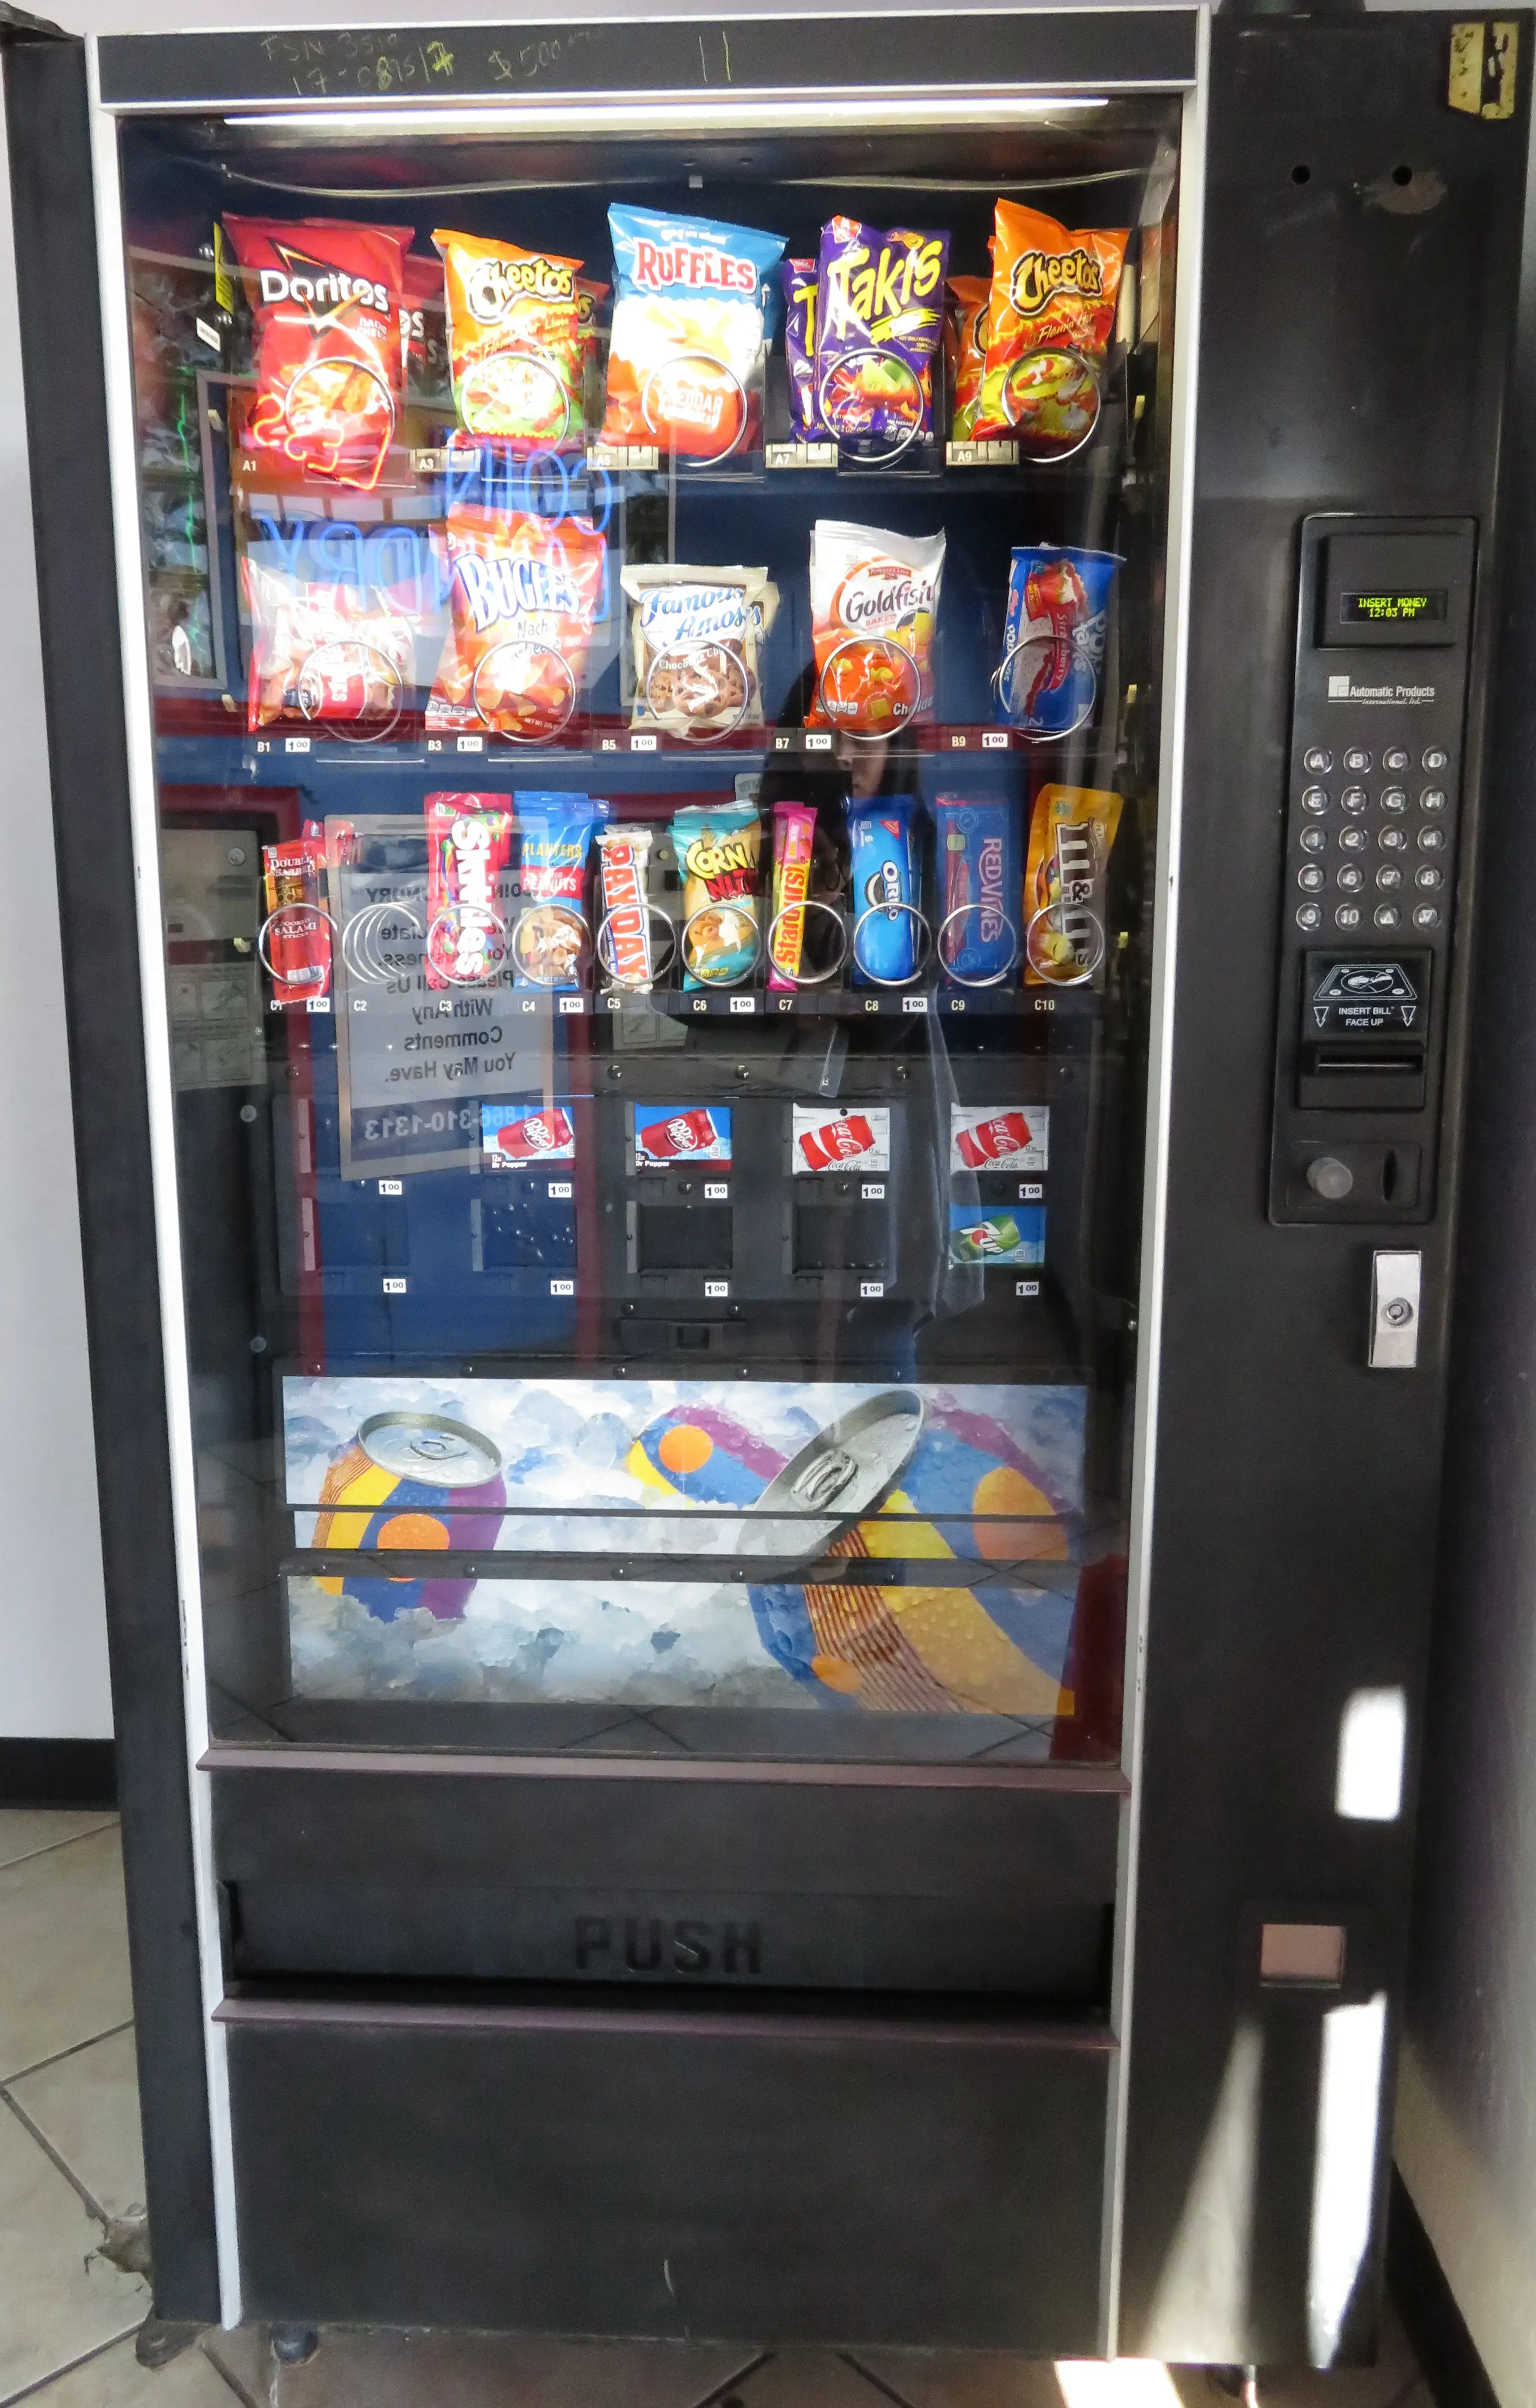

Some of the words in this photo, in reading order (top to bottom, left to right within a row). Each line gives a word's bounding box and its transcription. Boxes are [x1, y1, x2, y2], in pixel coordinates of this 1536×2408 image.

[1011, 251, 1102, 315] Cheetos
[259, 269, 389, 314] Doritos
[469, 259, 573, 324] Cheetos
[828, 240, 943, 341] Takis
[596, 454, 611, 466] A5
[775, 453, 790, 465] A7
[957, 451, 972, 463] A9
[242, 459, 256, 471] A1
[418, 458, 434, 470] A3
[639, 587, 745, 628] Famous
[846, 580, 932, 623] Goldfish
[1358, 597, 1393, 609] INSERT
[1397, 597, 1428, 608] MONEY
[1369, 607, 1397, 618] 12:03
[1402, 608, 1415, 618] PM
[517, 619, 558, 638] Nach
[1349, 686, 1394, 697] Automatic
[1395, 685, 1435, 698] Products
[257, 741, 271, 753] B1
[428, 740, 442, 751] B3
[602, 739, 616, 750] B5
[775, 738, 789, 750] B7
[951, 736, 966, 747] B9
[522, 842, 583, 859] PLANTERS
[270, 855, 313, 869] DOUBLE
[687, 839, 749, 879] CORN
[274, 865, 314, 877] BARRL
[523, 877, 577, 892] PEANUTS
[601, 843, 650, 980] PAYDAY
[274, 922, 317, 936] SALAMI
[353, 1000, 367, 1011] C2
[439, 1000, 453, 1012] C3
[522, 1000, 536, 1012] C4
[607, 998, 621, 1009] C5
[693, 999, 707, 1011] C6
[779, 999, 793, 1011] C7
[865, 999, 879, 1011] C8
[951, 999, 965, 1011] C9
[1034, 999, 1055, 1011] C10
[1372, 1007, 1392, 1015] BILL
[574, 1917, 761, 1974] PUSH
